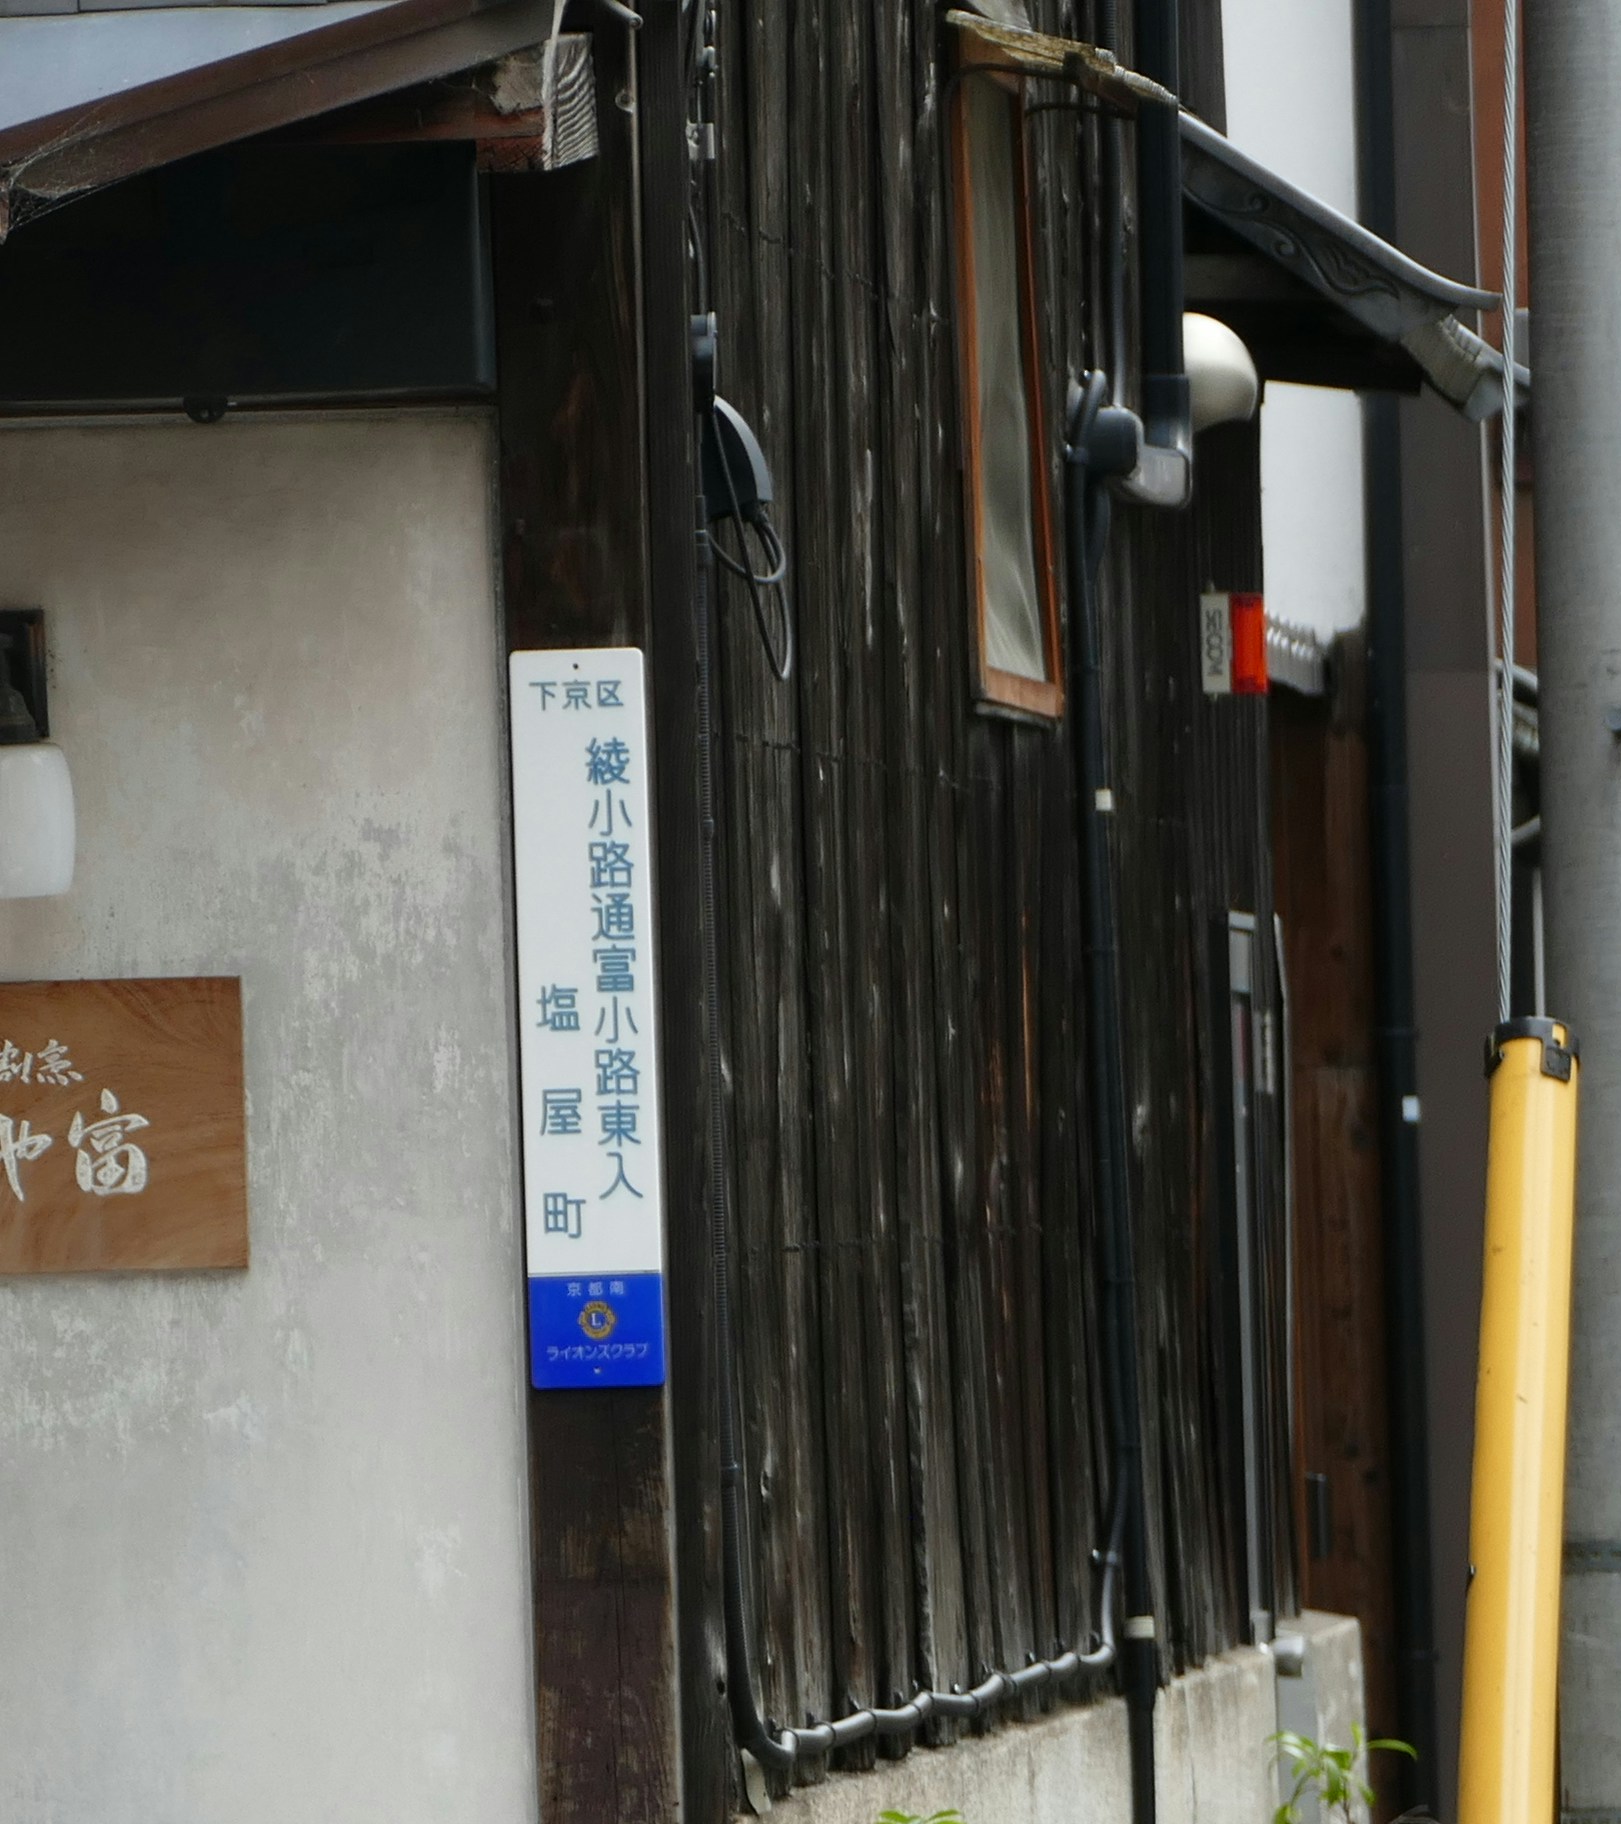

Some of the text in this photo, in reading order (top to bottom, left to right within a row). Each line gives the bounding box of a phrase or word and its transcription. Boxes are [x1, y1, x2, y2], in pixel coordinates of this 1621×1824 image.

[529, 679, 624, 711] 下京区
[585, 737, 643, 1200] 綾小路通富小路東入
[536, 983, 587, 1239] 塩屋町
[567, 1281, 624, 1296] 京都南
[547, 1343, 648, 1361] ライオンズクラブ
